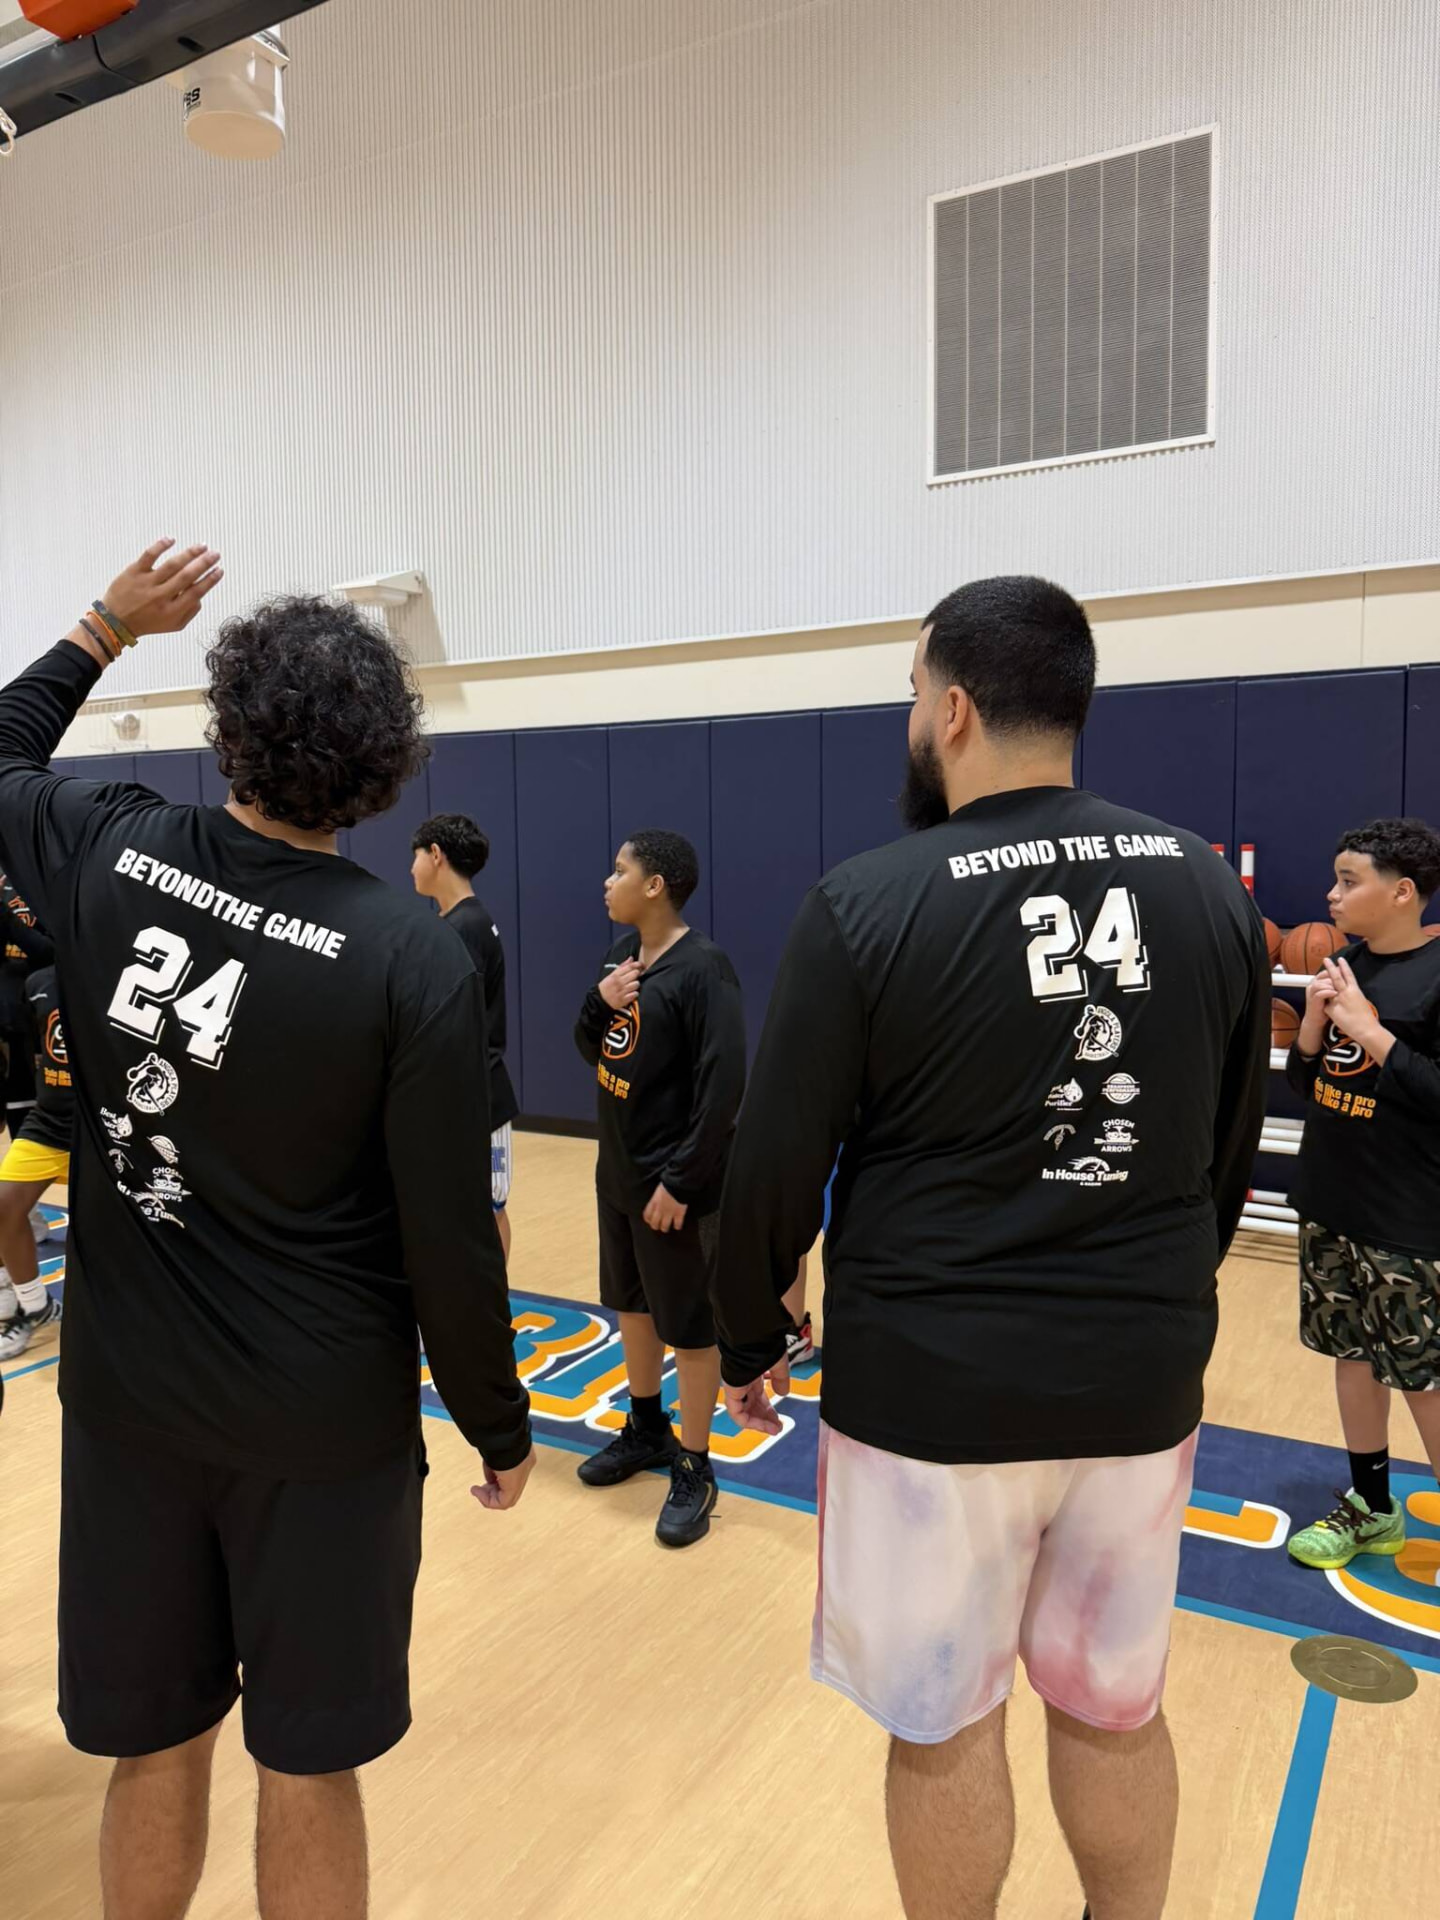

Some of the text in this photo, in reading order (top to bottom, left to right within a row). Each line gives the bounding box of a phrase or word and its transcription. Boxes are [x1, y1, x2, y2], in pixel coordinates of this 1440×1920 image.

[948, 834, 1184, 880] BEYOND THE GAME
[262, 912, 347, 960] GAME
[1019, 886, 1152, 1004] 24
[107, 926, 248, 1071] 24
[617, 1077, 631, 1090] pro
[1325, 1083, 1342, 1099] like
[1343, 1092, 1352, 1102] a
[1354, 1095, 1377, 1108] pro
[1322, 1095, 1340, 1109] like
[1341, 1103, 1349, 1112] a
[1350, 1104, 1374, 1118] pro
[1102, 1118, 1136, 1129] CHOSEN
[1100, 1145, 1133, 1153] ARROWS
[1041, 1168, 1129, 1182] In House Tuning
